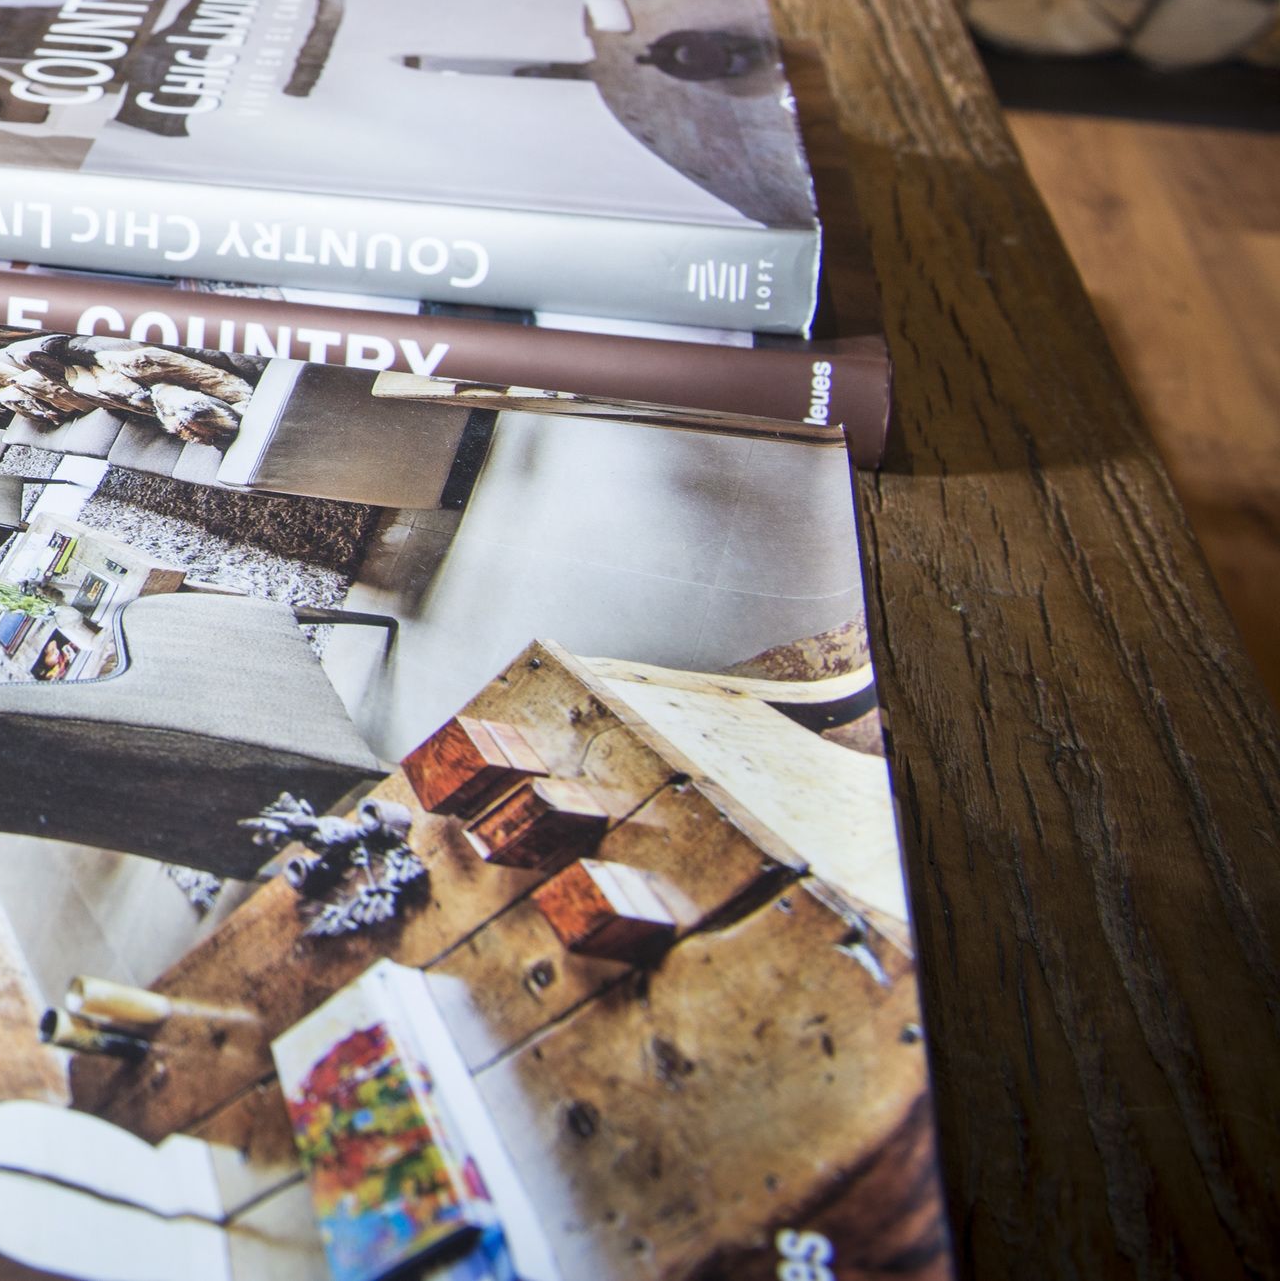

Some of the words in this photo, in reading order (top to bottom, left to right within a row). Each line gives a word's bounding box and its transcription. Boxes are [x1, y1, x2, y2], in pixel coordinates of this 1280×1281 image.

[136, 50, 239, 114] CHIC
[71, 206, 201, 261] CHIC
[217, 228, 489, 288] COUNTRY
[755, 259, 774, 311] LOFT
